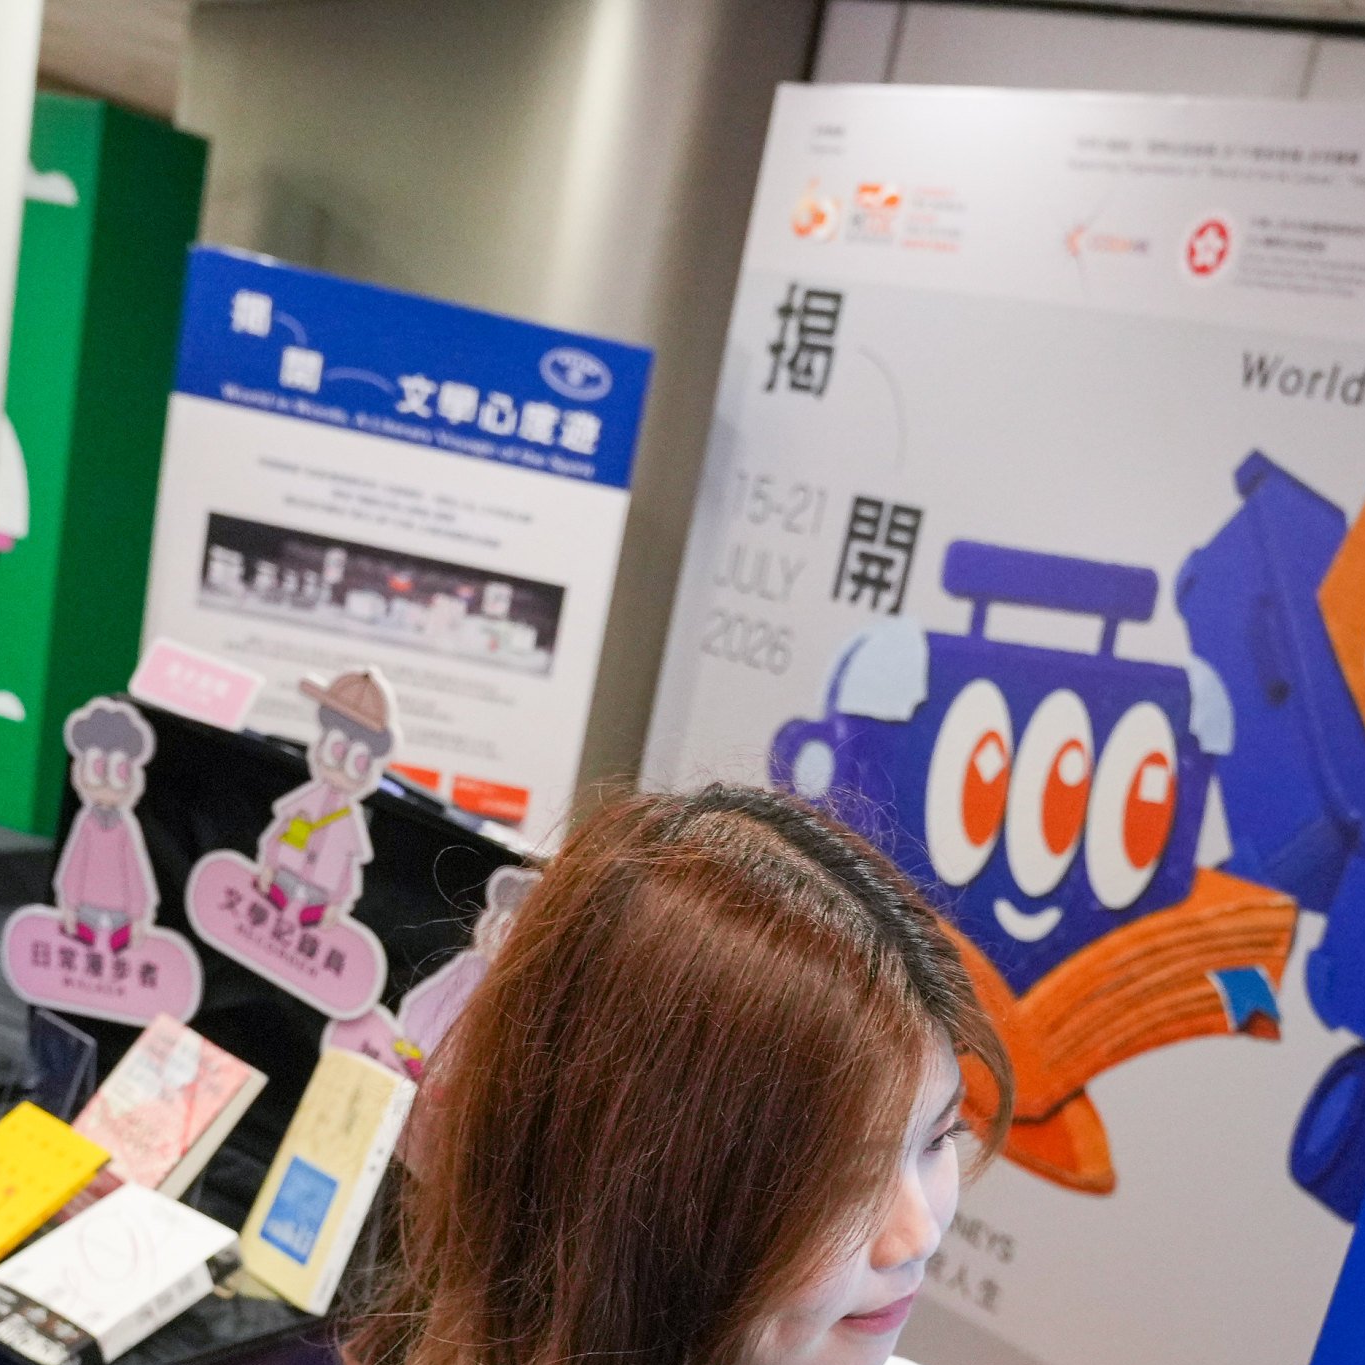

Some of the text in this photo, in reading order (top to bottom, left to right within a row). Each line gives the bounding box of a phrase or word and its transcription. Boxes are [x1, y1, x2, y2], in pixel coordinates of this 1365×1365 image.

[761, 281, 843, 399] 揭
[735, 470, 827, 538] 15-21
[711, 539, 806, 603] JULY
[831, 494, 924, 616] 開
[699, 608, 794, 676] 2026
